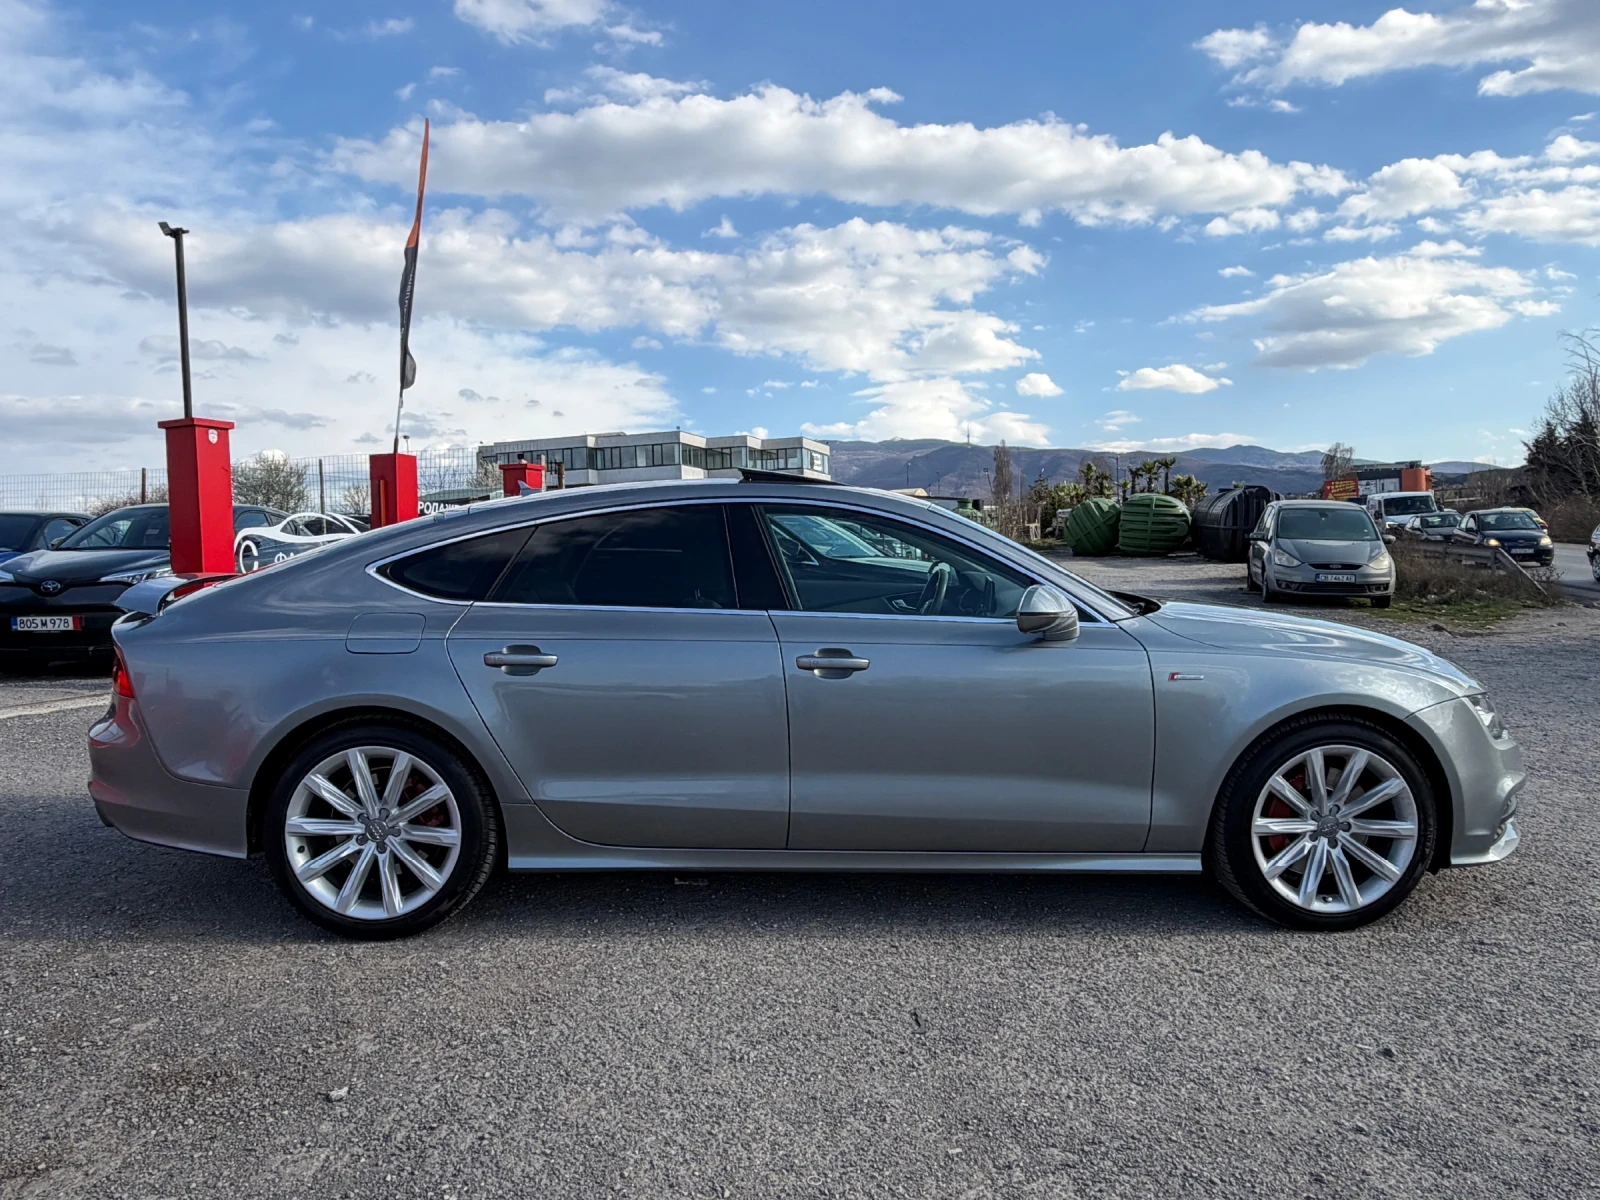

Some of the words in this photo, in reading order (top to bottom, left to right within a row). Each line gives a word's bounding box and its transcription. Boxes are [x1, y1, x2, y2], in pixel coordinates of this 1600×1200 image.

[19, 618, 39, 629] 805
[40, 618, 48, 629] M
[49, 618, 70, 629] 978
